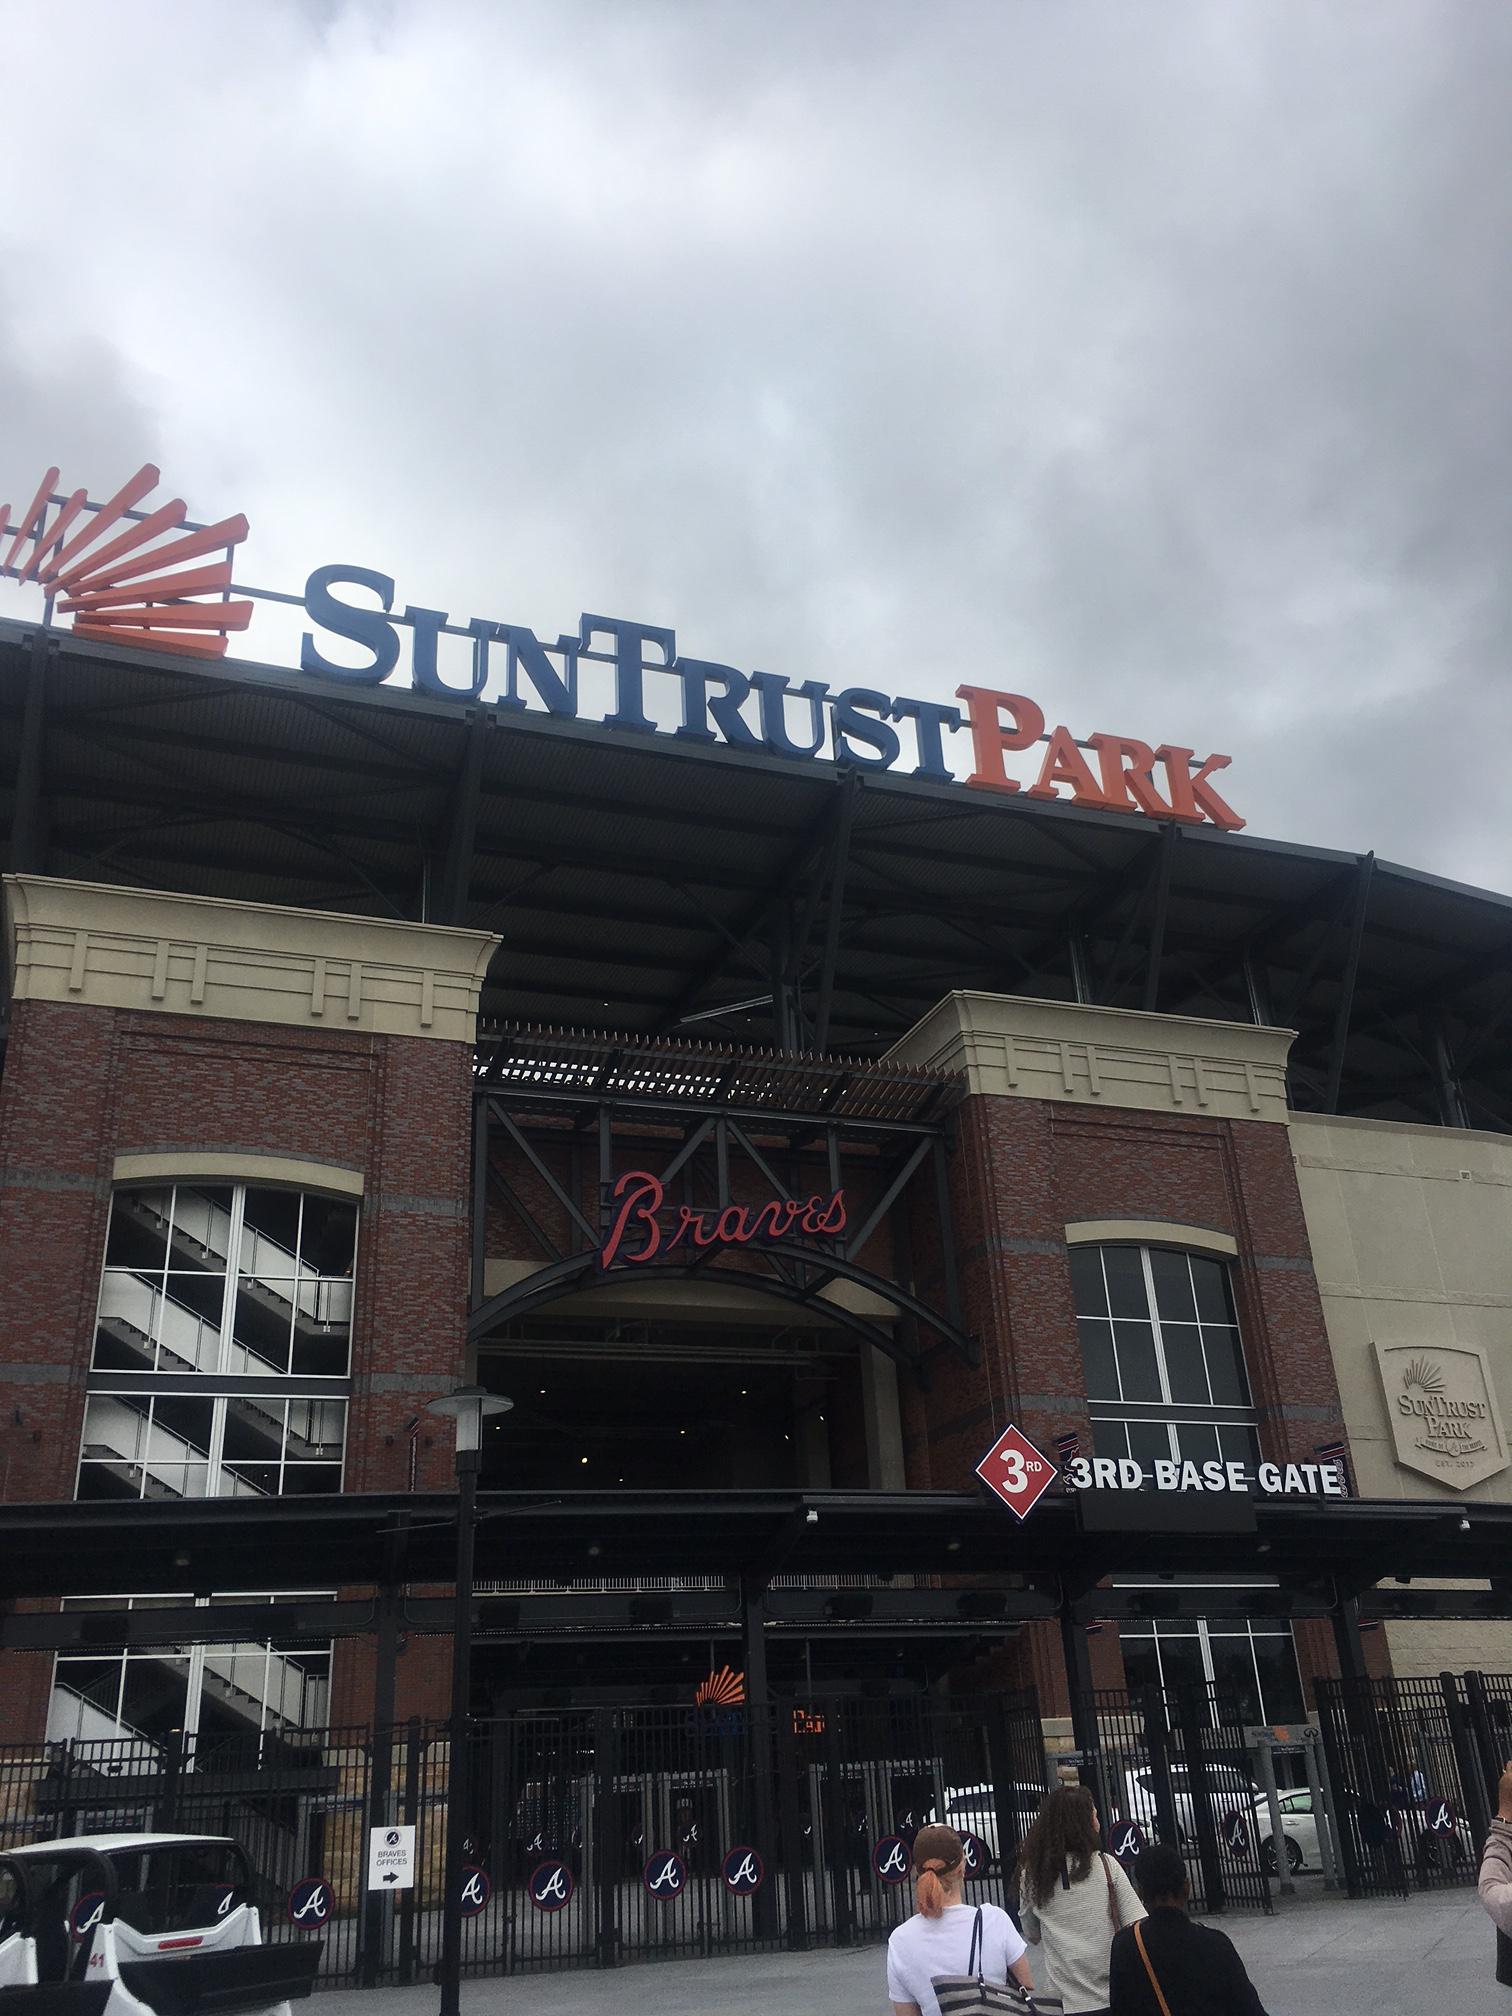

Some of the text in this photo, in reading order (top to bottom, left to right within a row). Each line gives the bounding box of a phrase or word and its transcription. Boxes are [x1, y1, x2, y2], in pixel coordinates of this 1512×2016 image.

[300, 564, 1247, 832] SUNTRUST PARK
[602, 1171, 847, 1271] Braves
[1399, 1394, 1486, 1439] SUNTRUST PARK
[1070, 1457, 1143, 1490] 3RD
[1154, 1459, 1249, 1493] BASE
[1258, 1462, 1341, 1495] GATE
[376, 1857, 408, 1867] OFFICES
[377, 1849, 407, 1858] BRAVES
